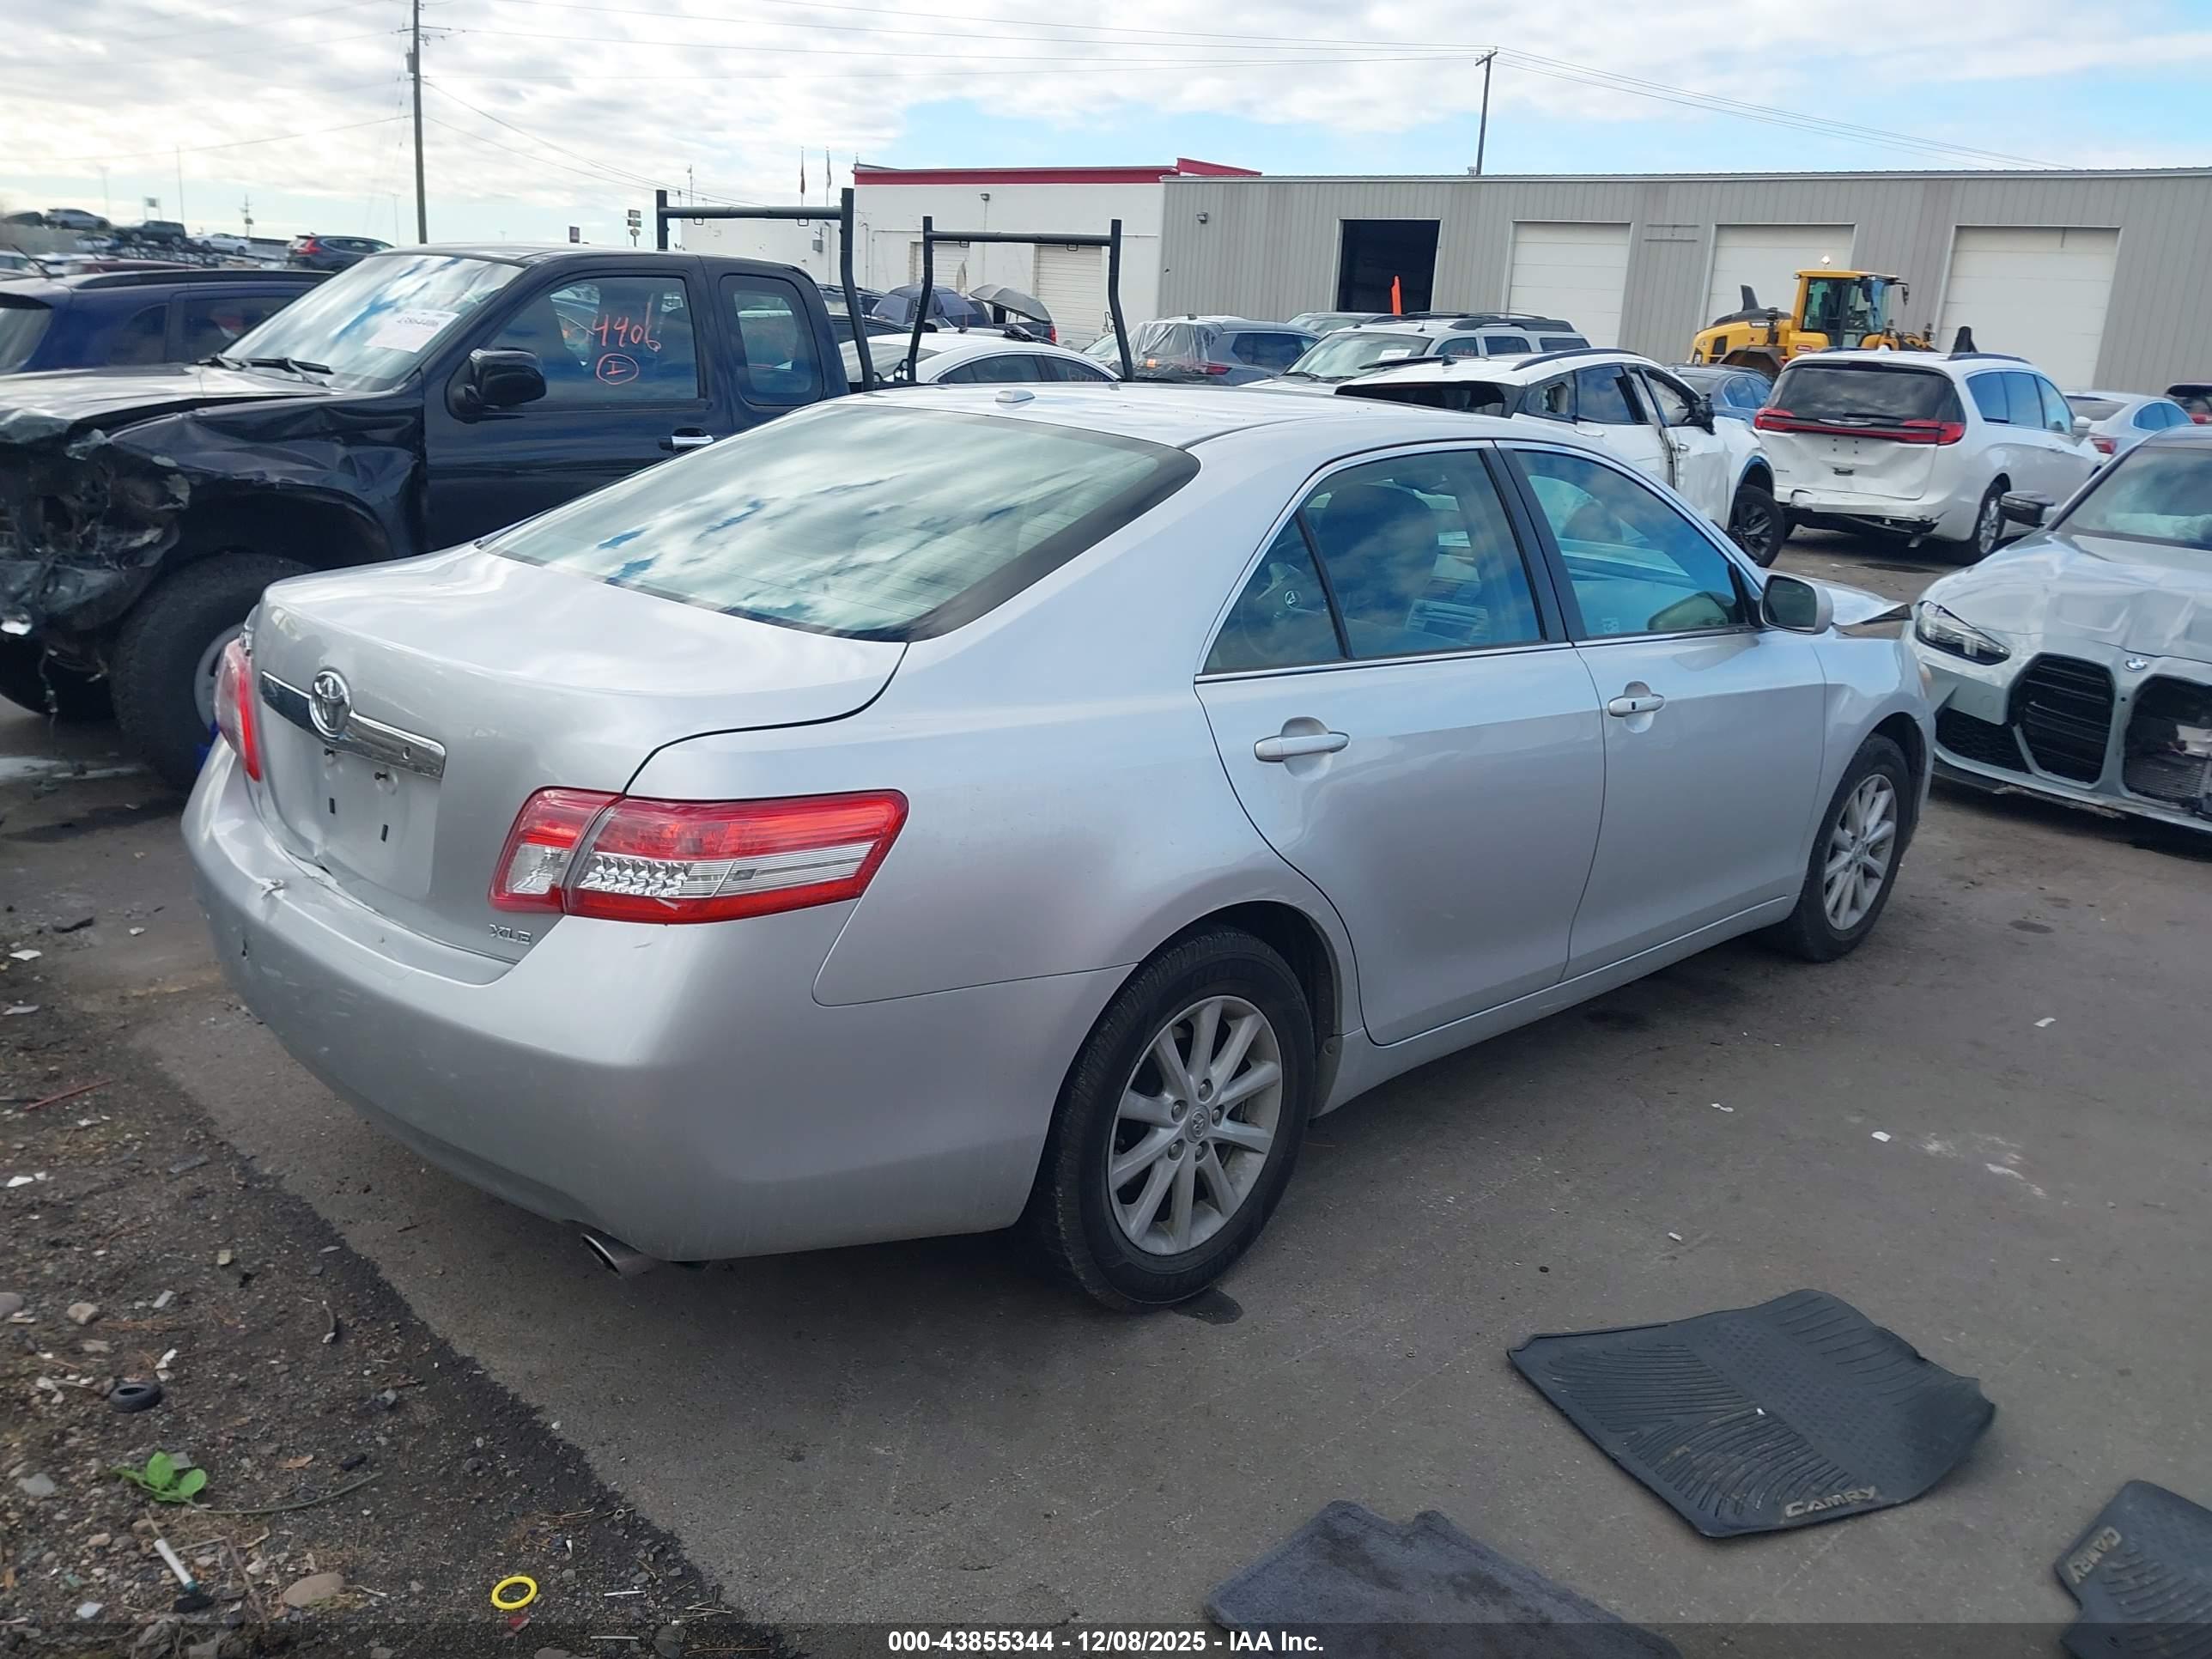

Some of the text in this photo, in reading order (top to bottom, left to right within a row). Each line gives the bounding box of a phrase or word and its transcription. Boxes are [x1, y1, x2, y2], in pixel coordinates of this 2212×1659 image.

[592, 293, 661, 353] 4406
[489, 923, 532, 945] XLE
[1785, 1486, 1876, 1517] CAMRY
[2067, 1526, 2123, 1584] CAMRY
